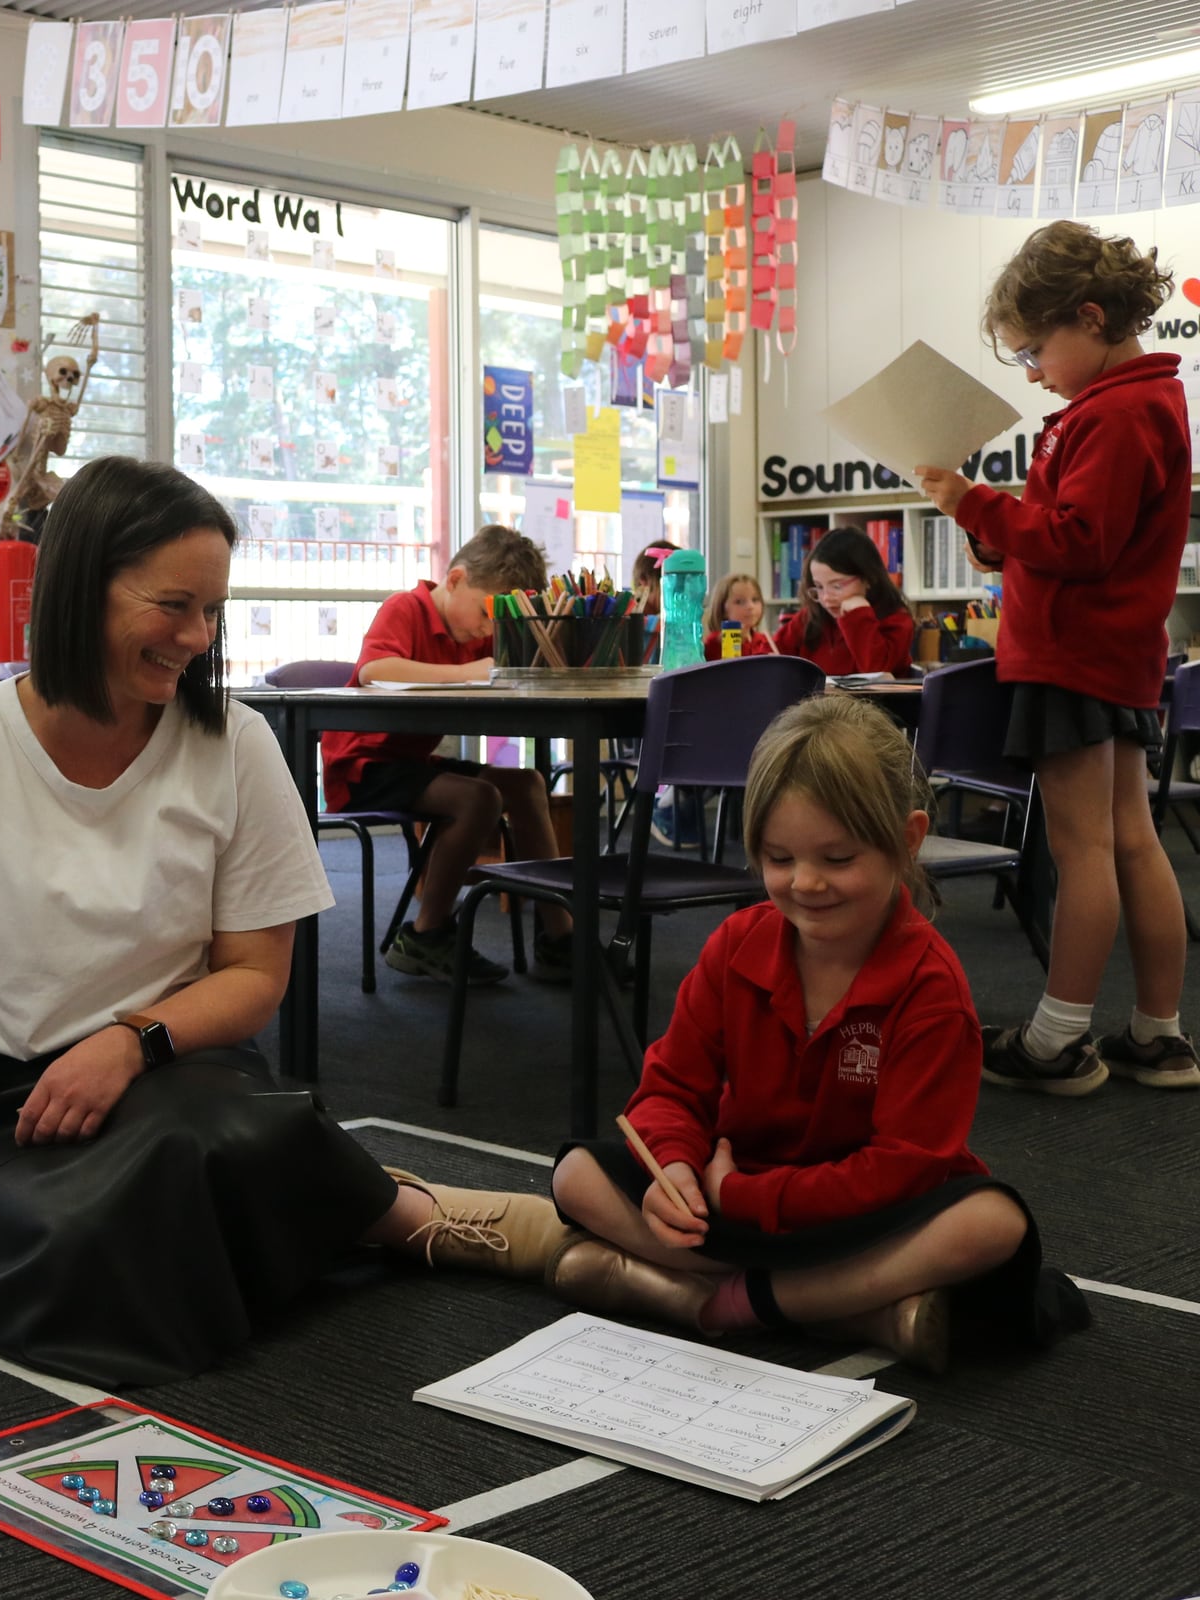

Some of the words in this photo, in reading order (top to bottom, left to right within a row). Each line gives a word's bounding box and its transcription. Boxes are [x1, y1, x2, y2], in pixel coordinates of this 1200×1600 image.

[732, 3, 762, 24] eight
[648, 24, 678, 40] seven
[575, 44, 591, 56] six
[80, 41, 107, 112] 3
[126, 38, 160, 112] 5
[173, 35, 221, 110] 10
[1179, 171, 1195, 195] Kk
[171, 177, 262, 223] Word
[1157, 314, 1200, 340] wo
[501, 383, 526, 456] DEEP
[837, 1072, 871, 1085] Primary
[491, 1392, 539, 1407] Sheet
[537, 1405, 620, 1431] Recording
[26, 1490, 87, 1525] watermelon
[83, 1522, 98, 1531] 4
[99, 1528, 150, 1555] between
[149, 1549, 181, 1566] seeds
[177, 1563, 201, 1576] 12
